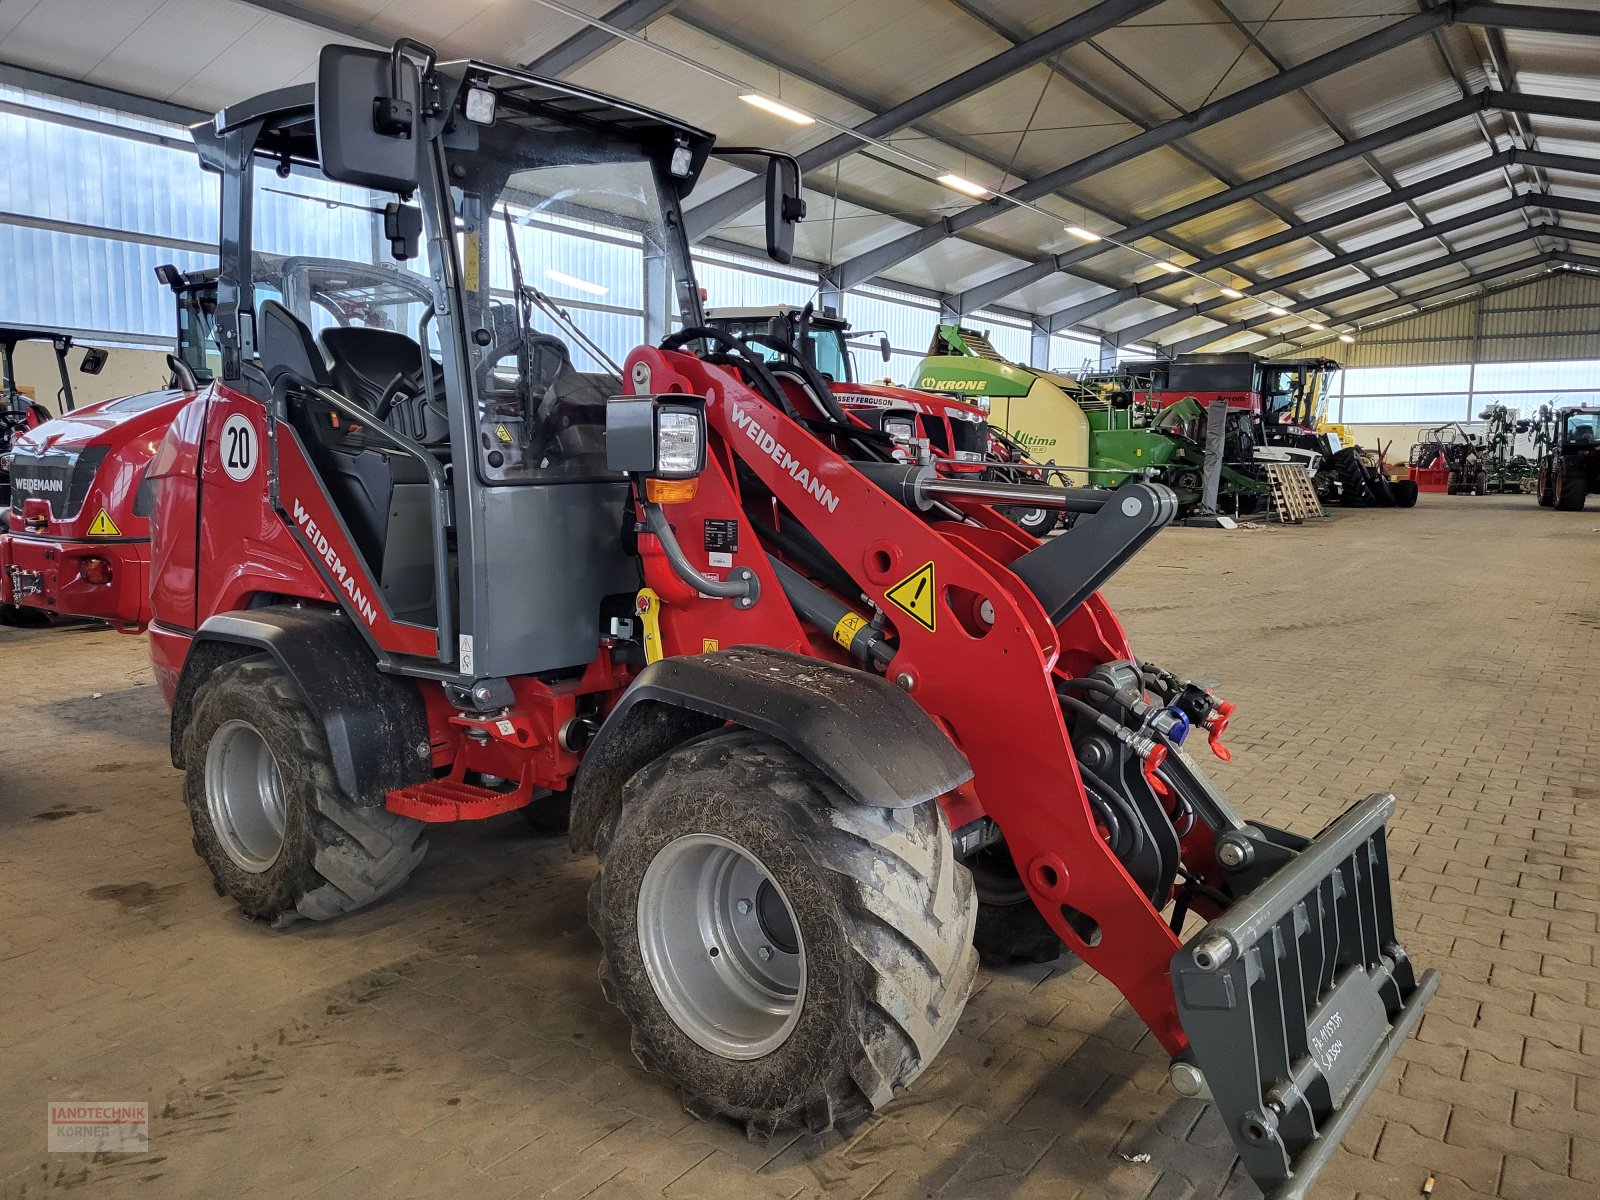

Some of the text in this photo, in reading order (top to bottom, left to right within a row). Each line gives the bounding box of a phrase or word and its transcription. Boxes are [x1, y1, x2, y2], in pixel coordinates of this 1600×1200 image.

[936, 380, 988, 391] KRONE
[834, 395, 894, 407] ASSEY FERGUSON
[1013, 429, 1057, 446] Ultima
[227, 426, 250, 469] 20
[729, 401, 841, 514] WEIDEMANN
[15, 478, 63, 492] WEIDEMANN
[292, 498, 377, 626] WEIDEMANN
